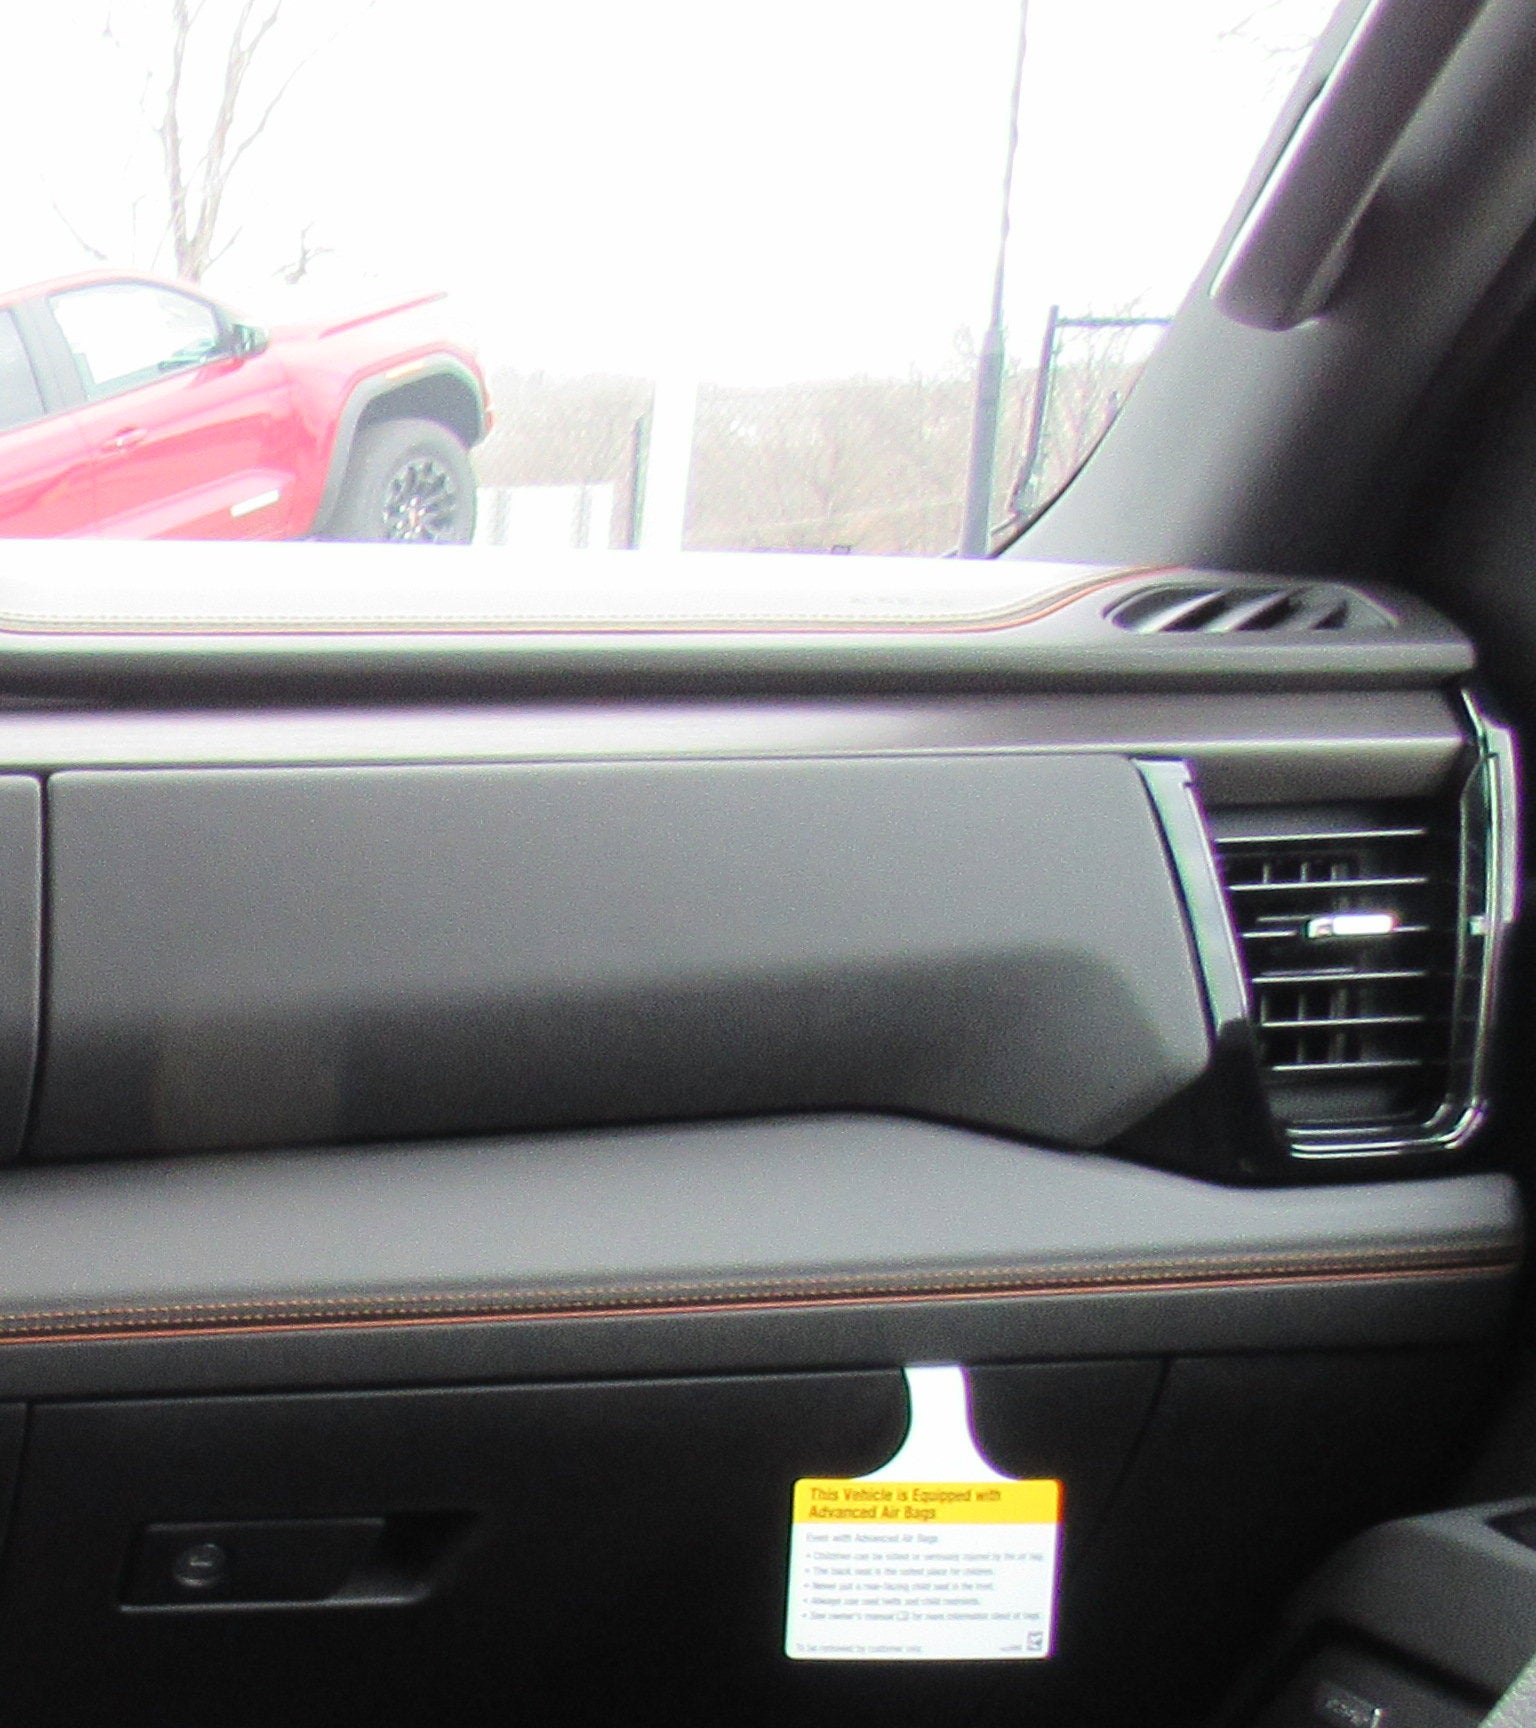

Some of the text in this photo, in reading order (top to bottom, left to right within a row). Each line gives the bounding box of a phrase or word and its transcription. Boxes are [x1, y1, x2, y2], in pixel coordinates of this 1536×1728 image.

[809, 1487, 1002, 1504] This Vehicle is Equipped with
[808, 1505, 937, 1521] Advanced Air Bags
